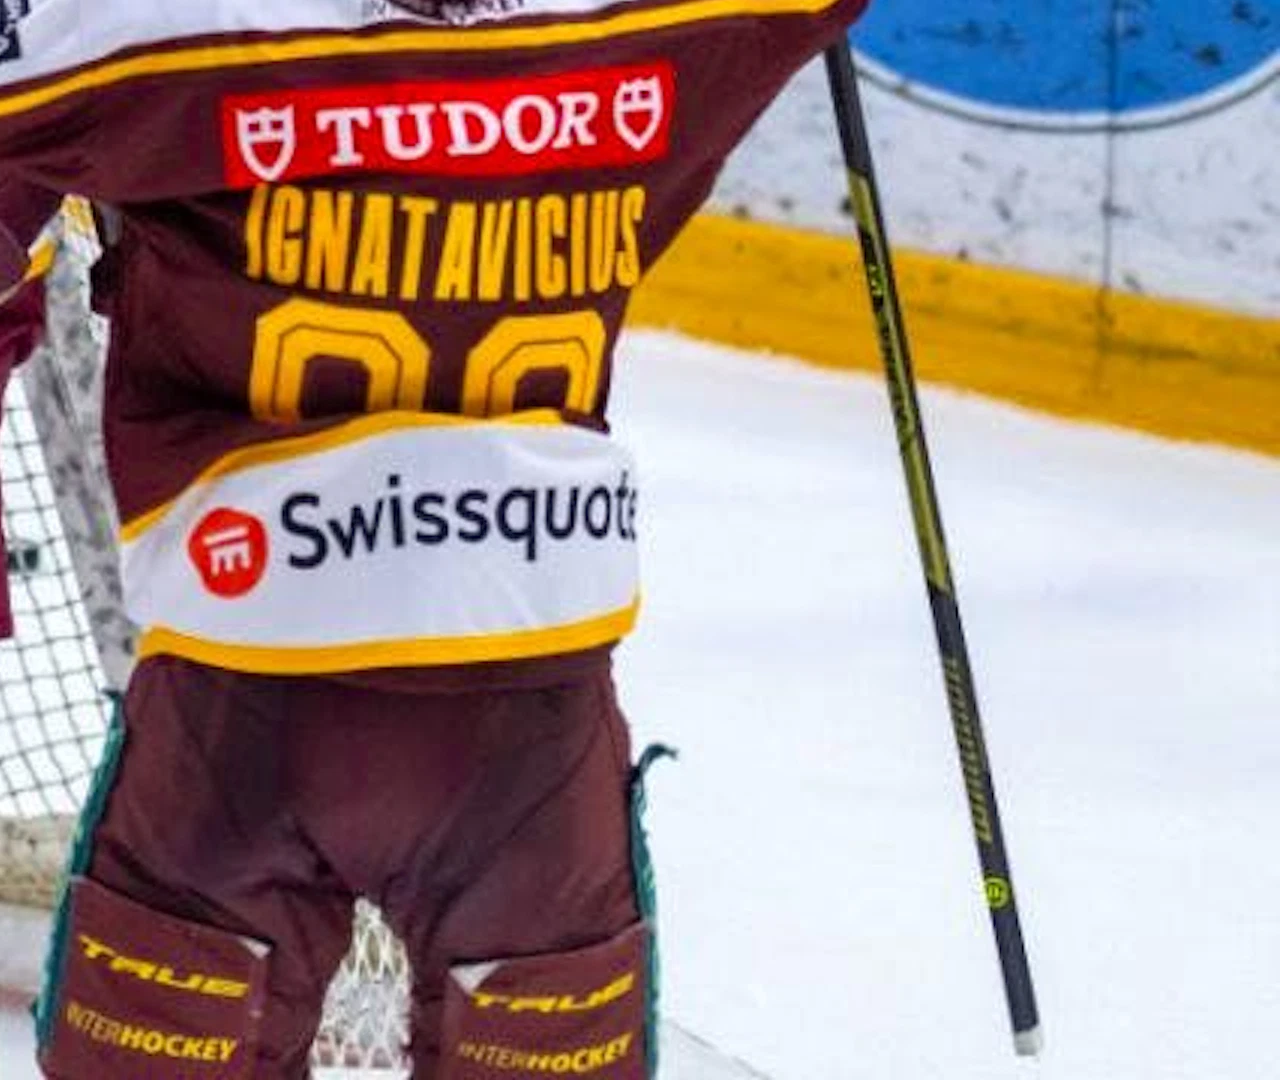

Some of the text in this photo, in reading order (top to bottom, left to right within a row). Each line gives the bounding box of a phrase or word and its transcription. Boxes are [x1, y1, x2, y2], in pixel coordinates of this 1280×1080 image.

[316, 91, 599, 168] TUDOR
[245, 182, 646, 302] IGNATAVICIUS
[76, 934, 251, 999] TRUE
[470, 972, 635, 1015] TRUE
[64, 1002, 238, 1063] INTERHOCKEY
[456, 1031, 634, 1076] INTERHOCKEY
